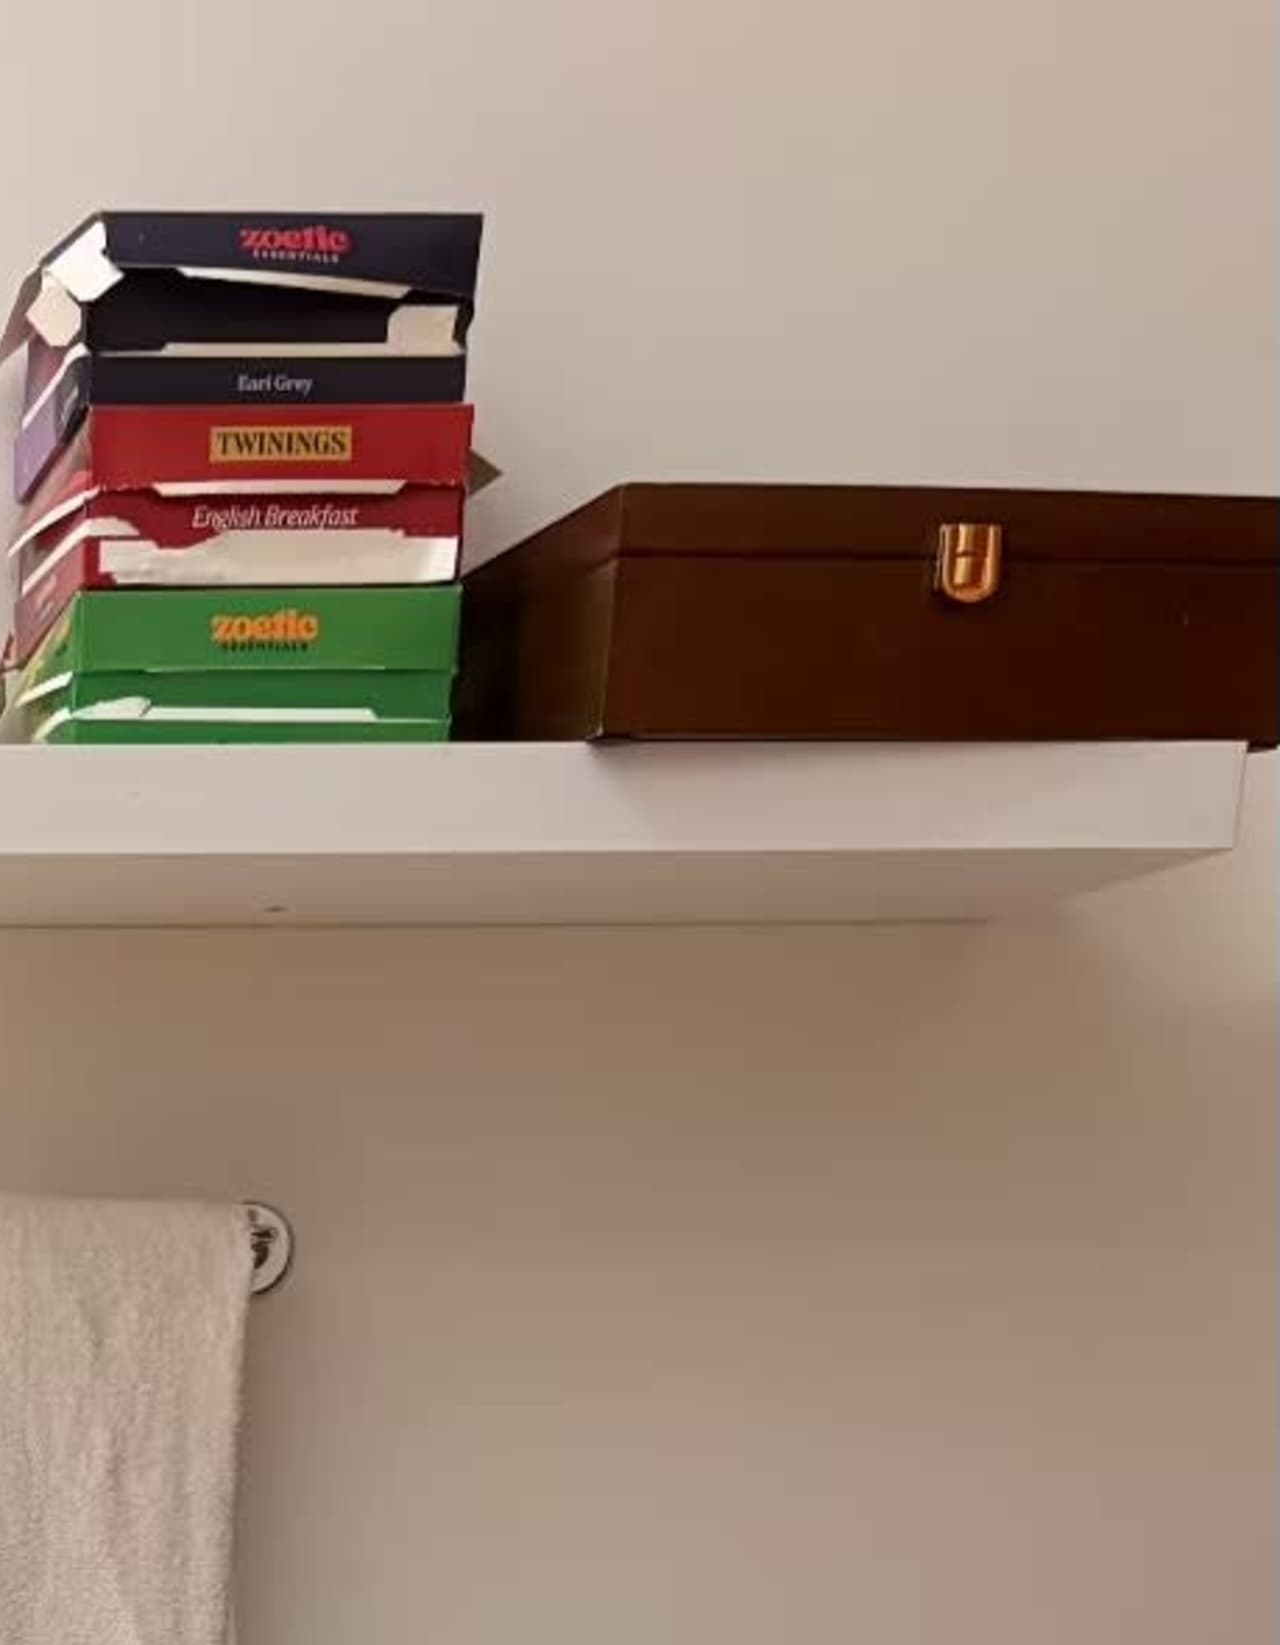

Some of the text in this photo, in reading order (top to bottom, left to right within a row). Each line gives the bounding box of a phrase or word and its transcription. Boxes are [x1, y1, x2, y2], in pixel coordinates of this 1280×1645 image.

[237, 374, 313, 398] Earl Grey
[217, 430, 347, 456] TWININGS
[192, 502, 359, 531] English Breakfast
